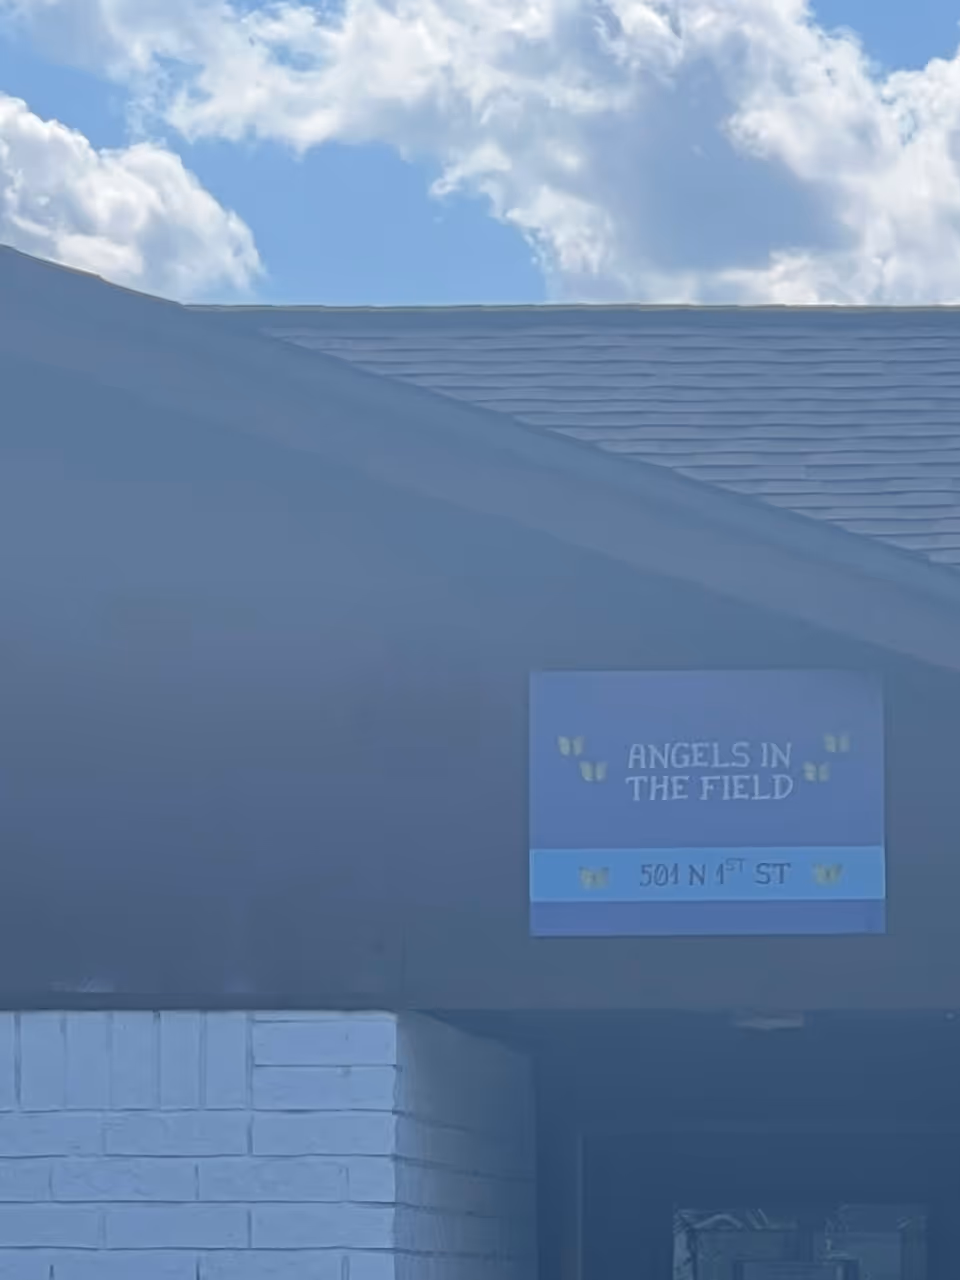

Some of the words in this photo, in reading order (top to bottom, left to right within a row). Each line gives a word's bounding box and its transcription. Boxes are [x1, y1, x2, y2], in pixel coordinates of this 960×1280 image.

[628, 742, 750, 769] ANGELS
[761, 742, 792, 768] IN
[626, 775, 689, 801] THE
[700, 775, 793, 801] FIELD
[640, 863, 679, 887] 501
[688, 863, 705, 887] N
[755, 862, 791, 885] ST
